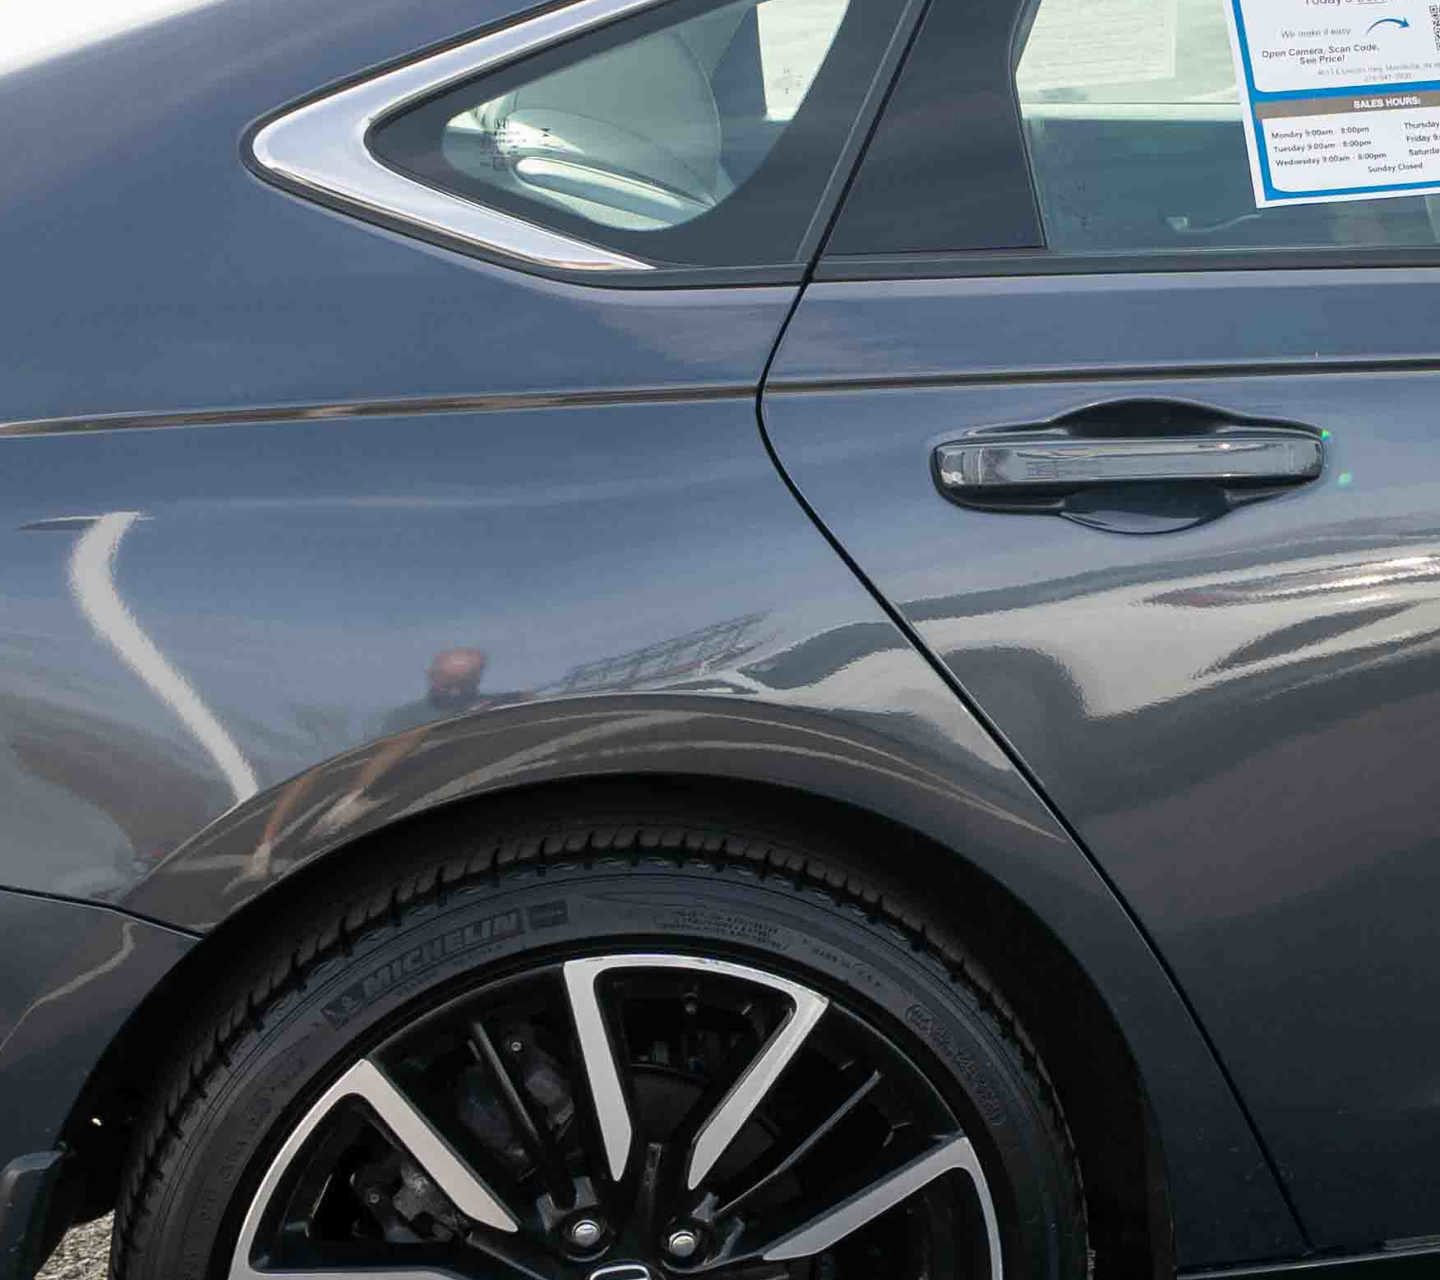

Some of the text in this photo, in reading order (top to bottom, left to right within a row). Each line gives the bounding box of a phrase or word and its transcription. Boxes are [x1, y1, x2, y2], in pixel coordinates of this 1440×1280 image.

[1262, 49, 1287, 61] Open
[1328, 44, 1351, 54] Scan
[1300, 56, 1317, 65] See
[1353, 96, 1421, 109] SALES HOURS:
[1404, 119, 1440, 130] Thursday
[1271, 129, 1303, 140] Monday
[1406, 133, 1432, 143] Friday
[1274, 142, 1305, 153] Tuesday
[1275, 156, 1321, 167] Wednesday
[1367, 161, 1423, 174] Sunday Closed
[364, 908, 524, 997] MICHELIN
